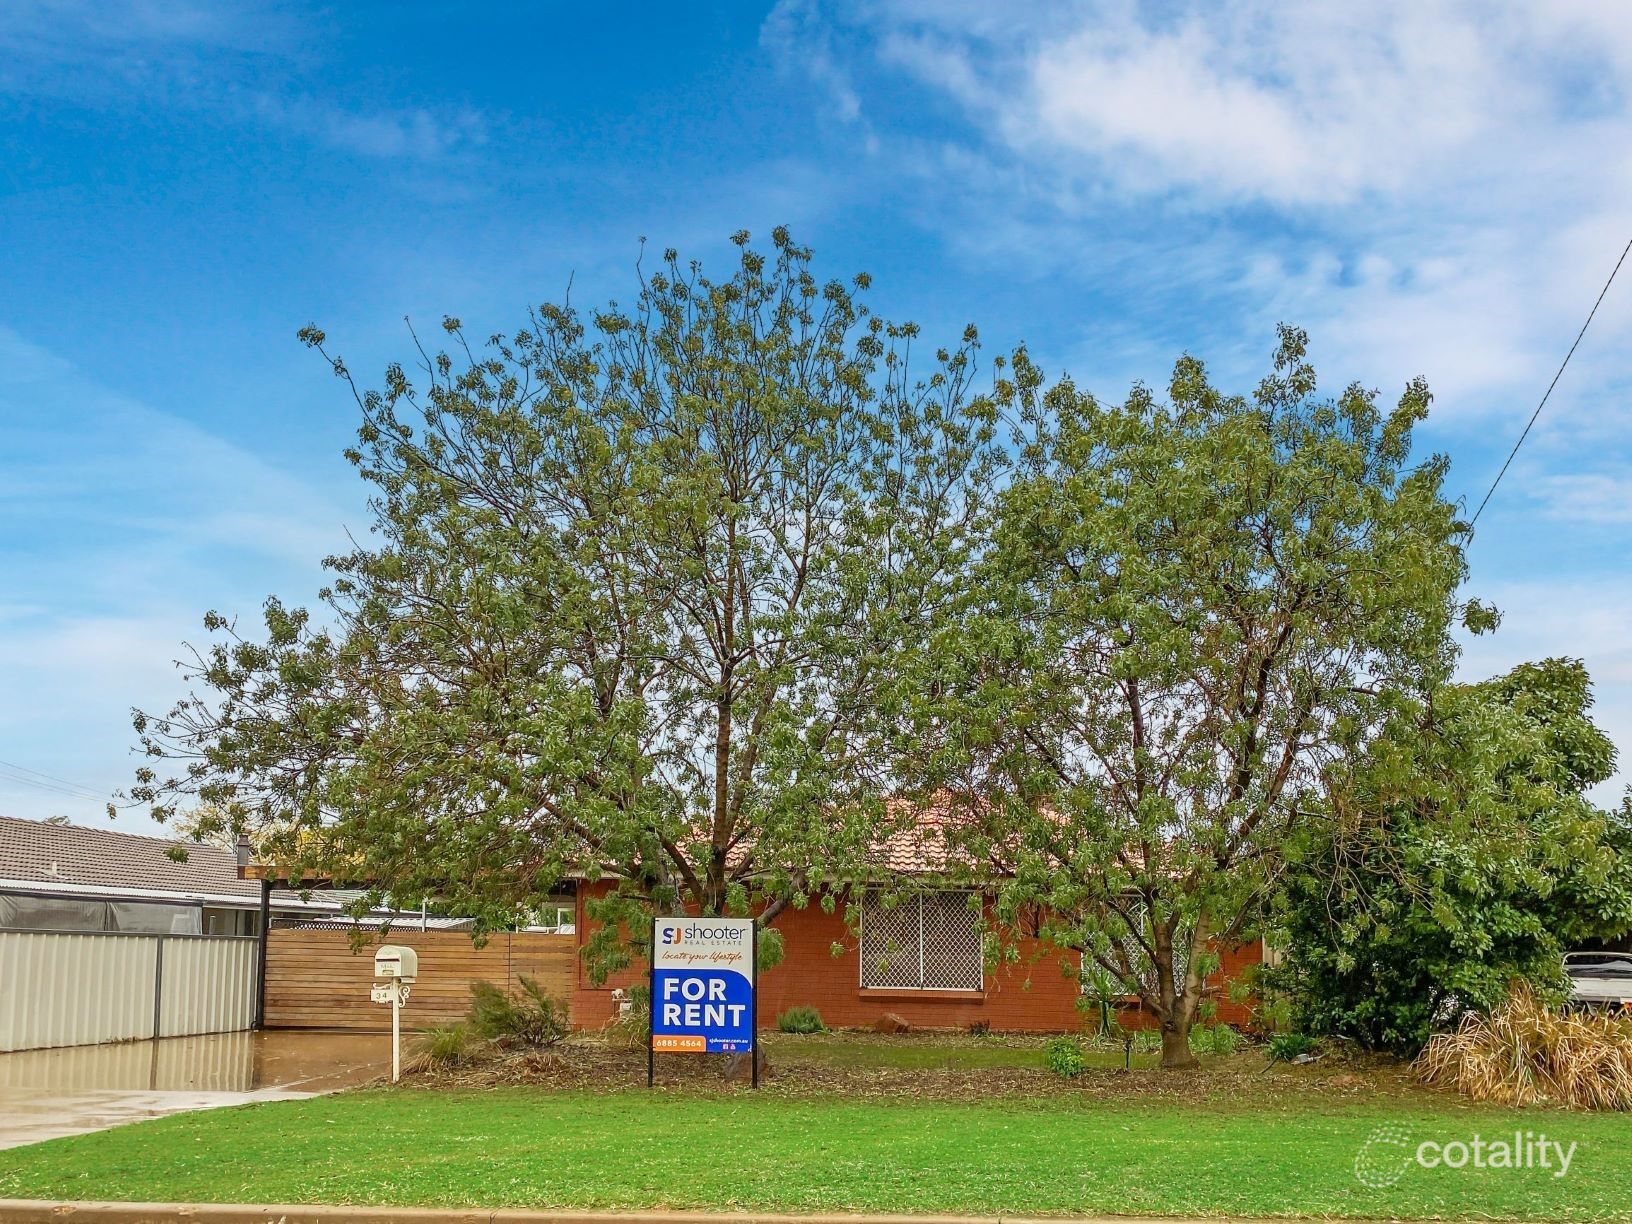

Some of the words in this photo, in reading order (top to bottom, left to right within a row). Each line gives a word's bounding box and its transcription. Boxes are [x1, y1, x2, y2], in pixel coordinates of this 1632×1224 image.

[662, 927, 682, 945] SJ
[684, 922, 746, 940] shooter
[661, 950, 688, 960] locate
[687, 953, 709, 965] your
[709, 950, 743, 965] lifestyle
[663, 977, 727, 1001] FOR
[663, 1004, 746, 1027] RENT
[656, 1039, 678, 1047] 6885
